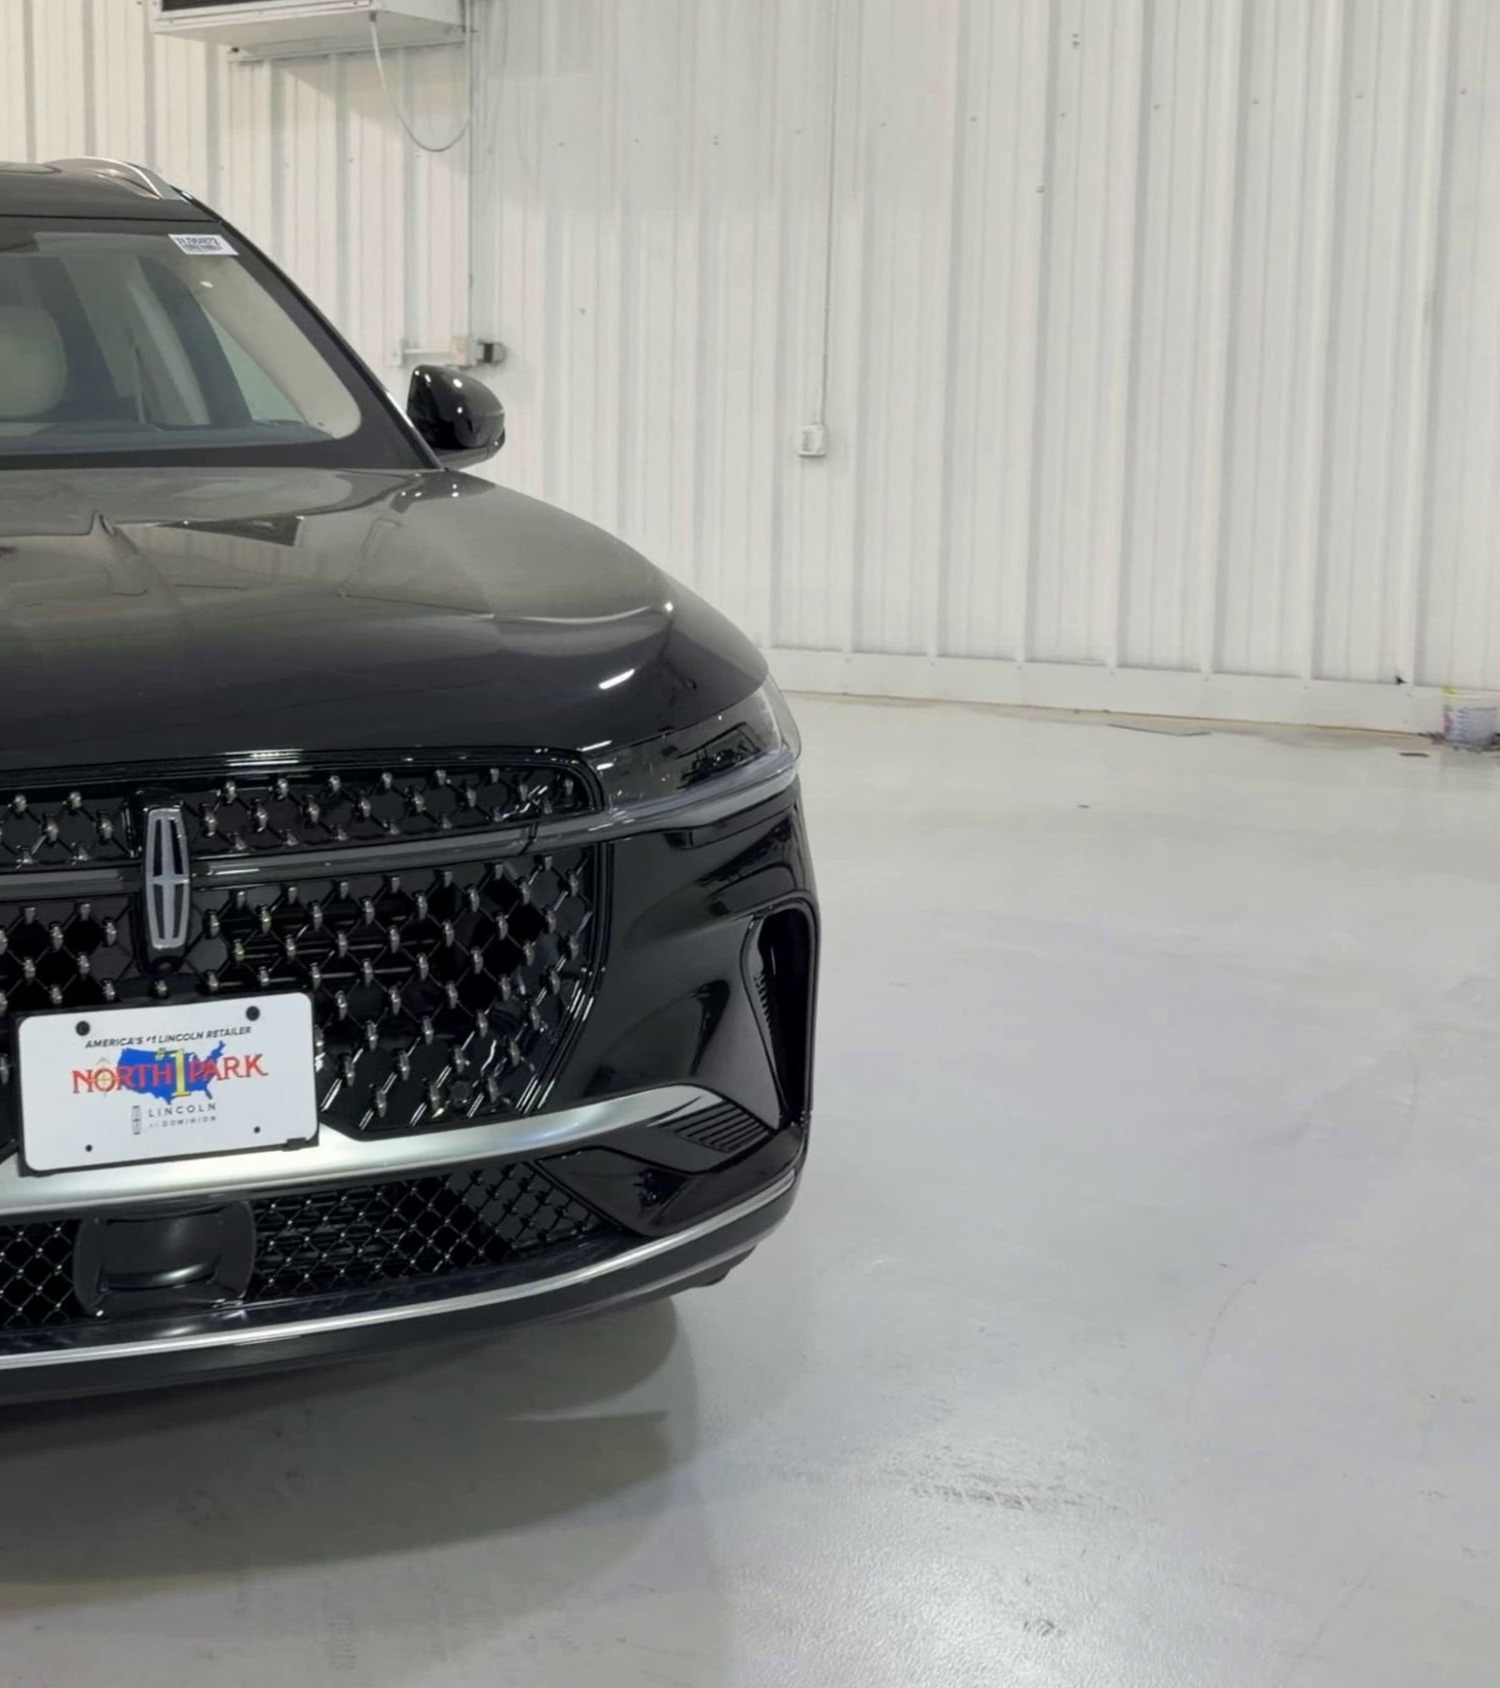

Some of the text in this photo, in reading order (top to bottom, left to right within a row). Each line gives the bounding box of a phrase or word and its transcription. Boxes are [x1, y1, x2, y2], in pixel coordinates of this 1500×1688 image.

[85, 1036, 143, 1049] AMERICA'S
[158, 1031, 204, 1044] LINCOLN
[206, 1026, 252, 1039] RETAILER
[72, 1053, 269, 1094] NORTH PARK
[148, 1102, 216, 1118] LINCOLN
